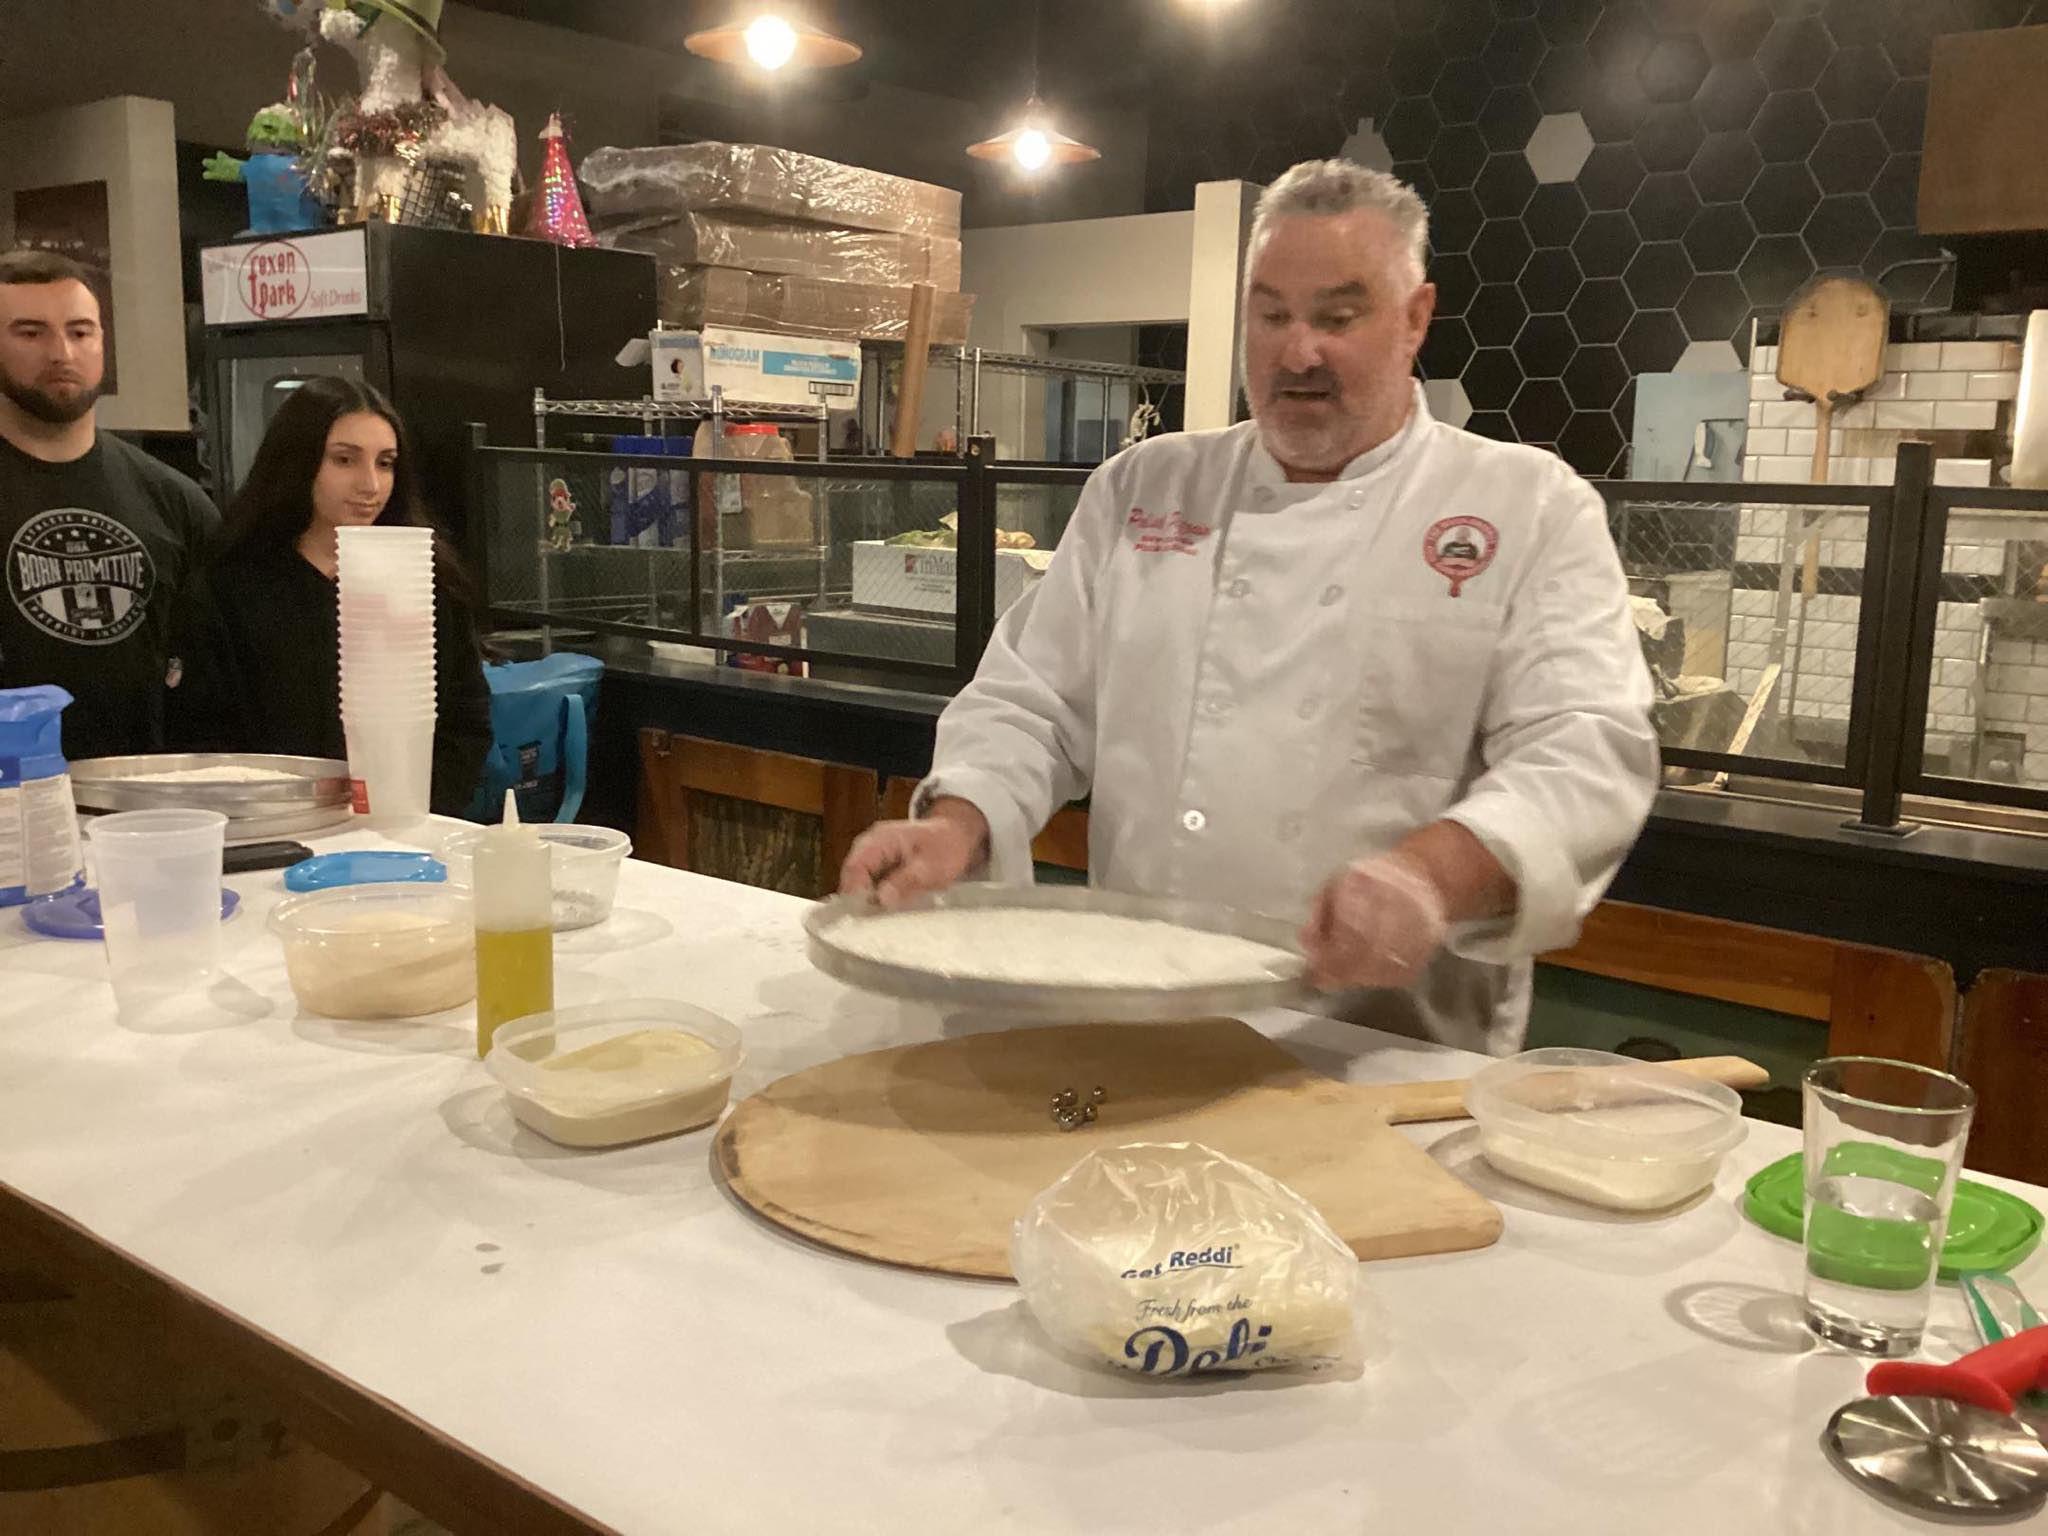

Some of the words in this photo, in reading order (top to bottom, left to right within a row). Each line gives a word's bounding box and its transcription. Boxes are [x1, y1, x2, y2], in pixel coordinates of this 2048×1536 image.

[17, 551, 62, 591] BORN
[64, 551, 144, 589] PRIMITIVE
[1169, 1246, 1233, 1268] Reddi
[1135, 1298, 1182, 1321] Fresh
[1180, 1298, 1221, 1322] from
[1227, 1294, 1253, 1311] the
